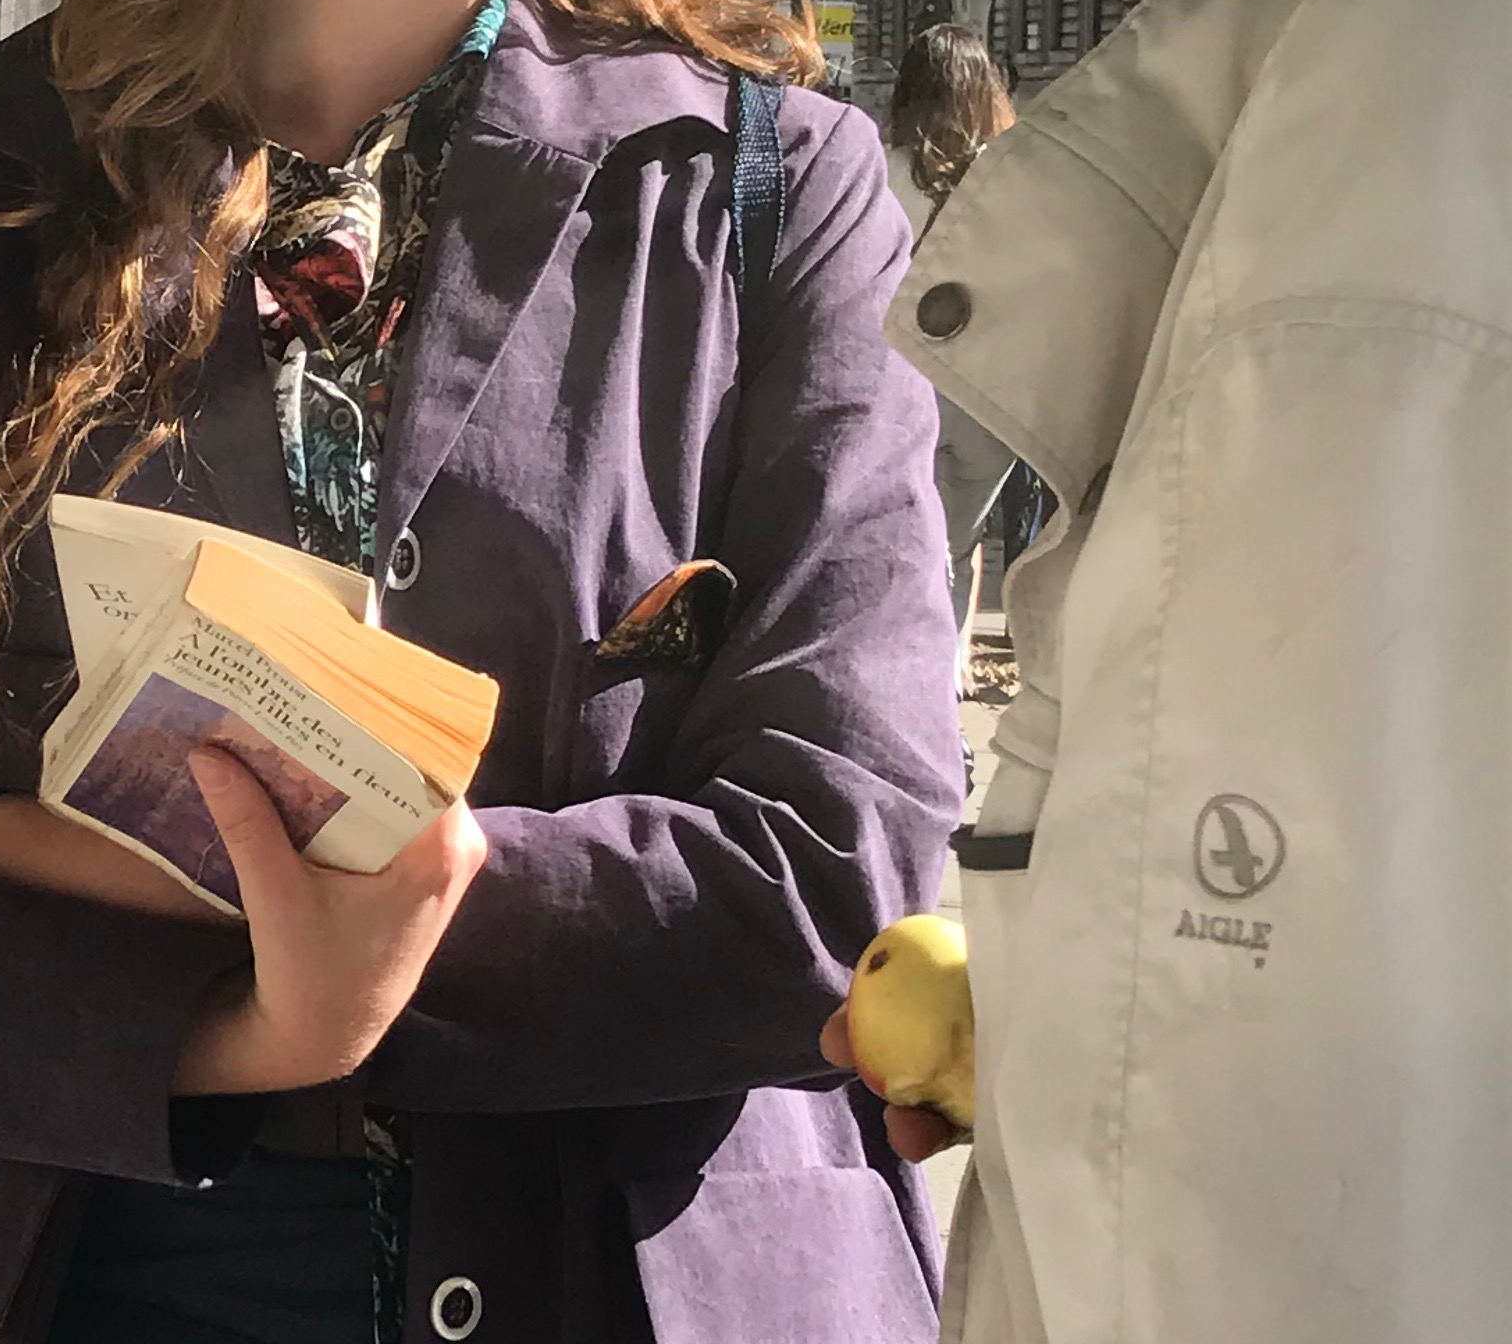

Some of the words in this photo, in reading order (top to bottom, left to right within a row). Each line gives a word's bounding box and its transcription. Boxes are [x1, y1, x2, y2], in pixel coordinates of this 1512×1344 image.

[83, 582, 133, 604] Et
[178, 628, 201, 651] À
[208, 641, 299, 713] l'ombre
[301, 712, 345, 749] des
[191, 614, 254, 658] Marcel
[255, 656, 307, 702] Proust
[172, 644, 255, 696] jeunes
[256, 693, 312, 744] filles
[315, 741, 346, 768] en
[349, 766, 422, 821] fleurs
[1173, 908, 1273, 952] AIGLE
